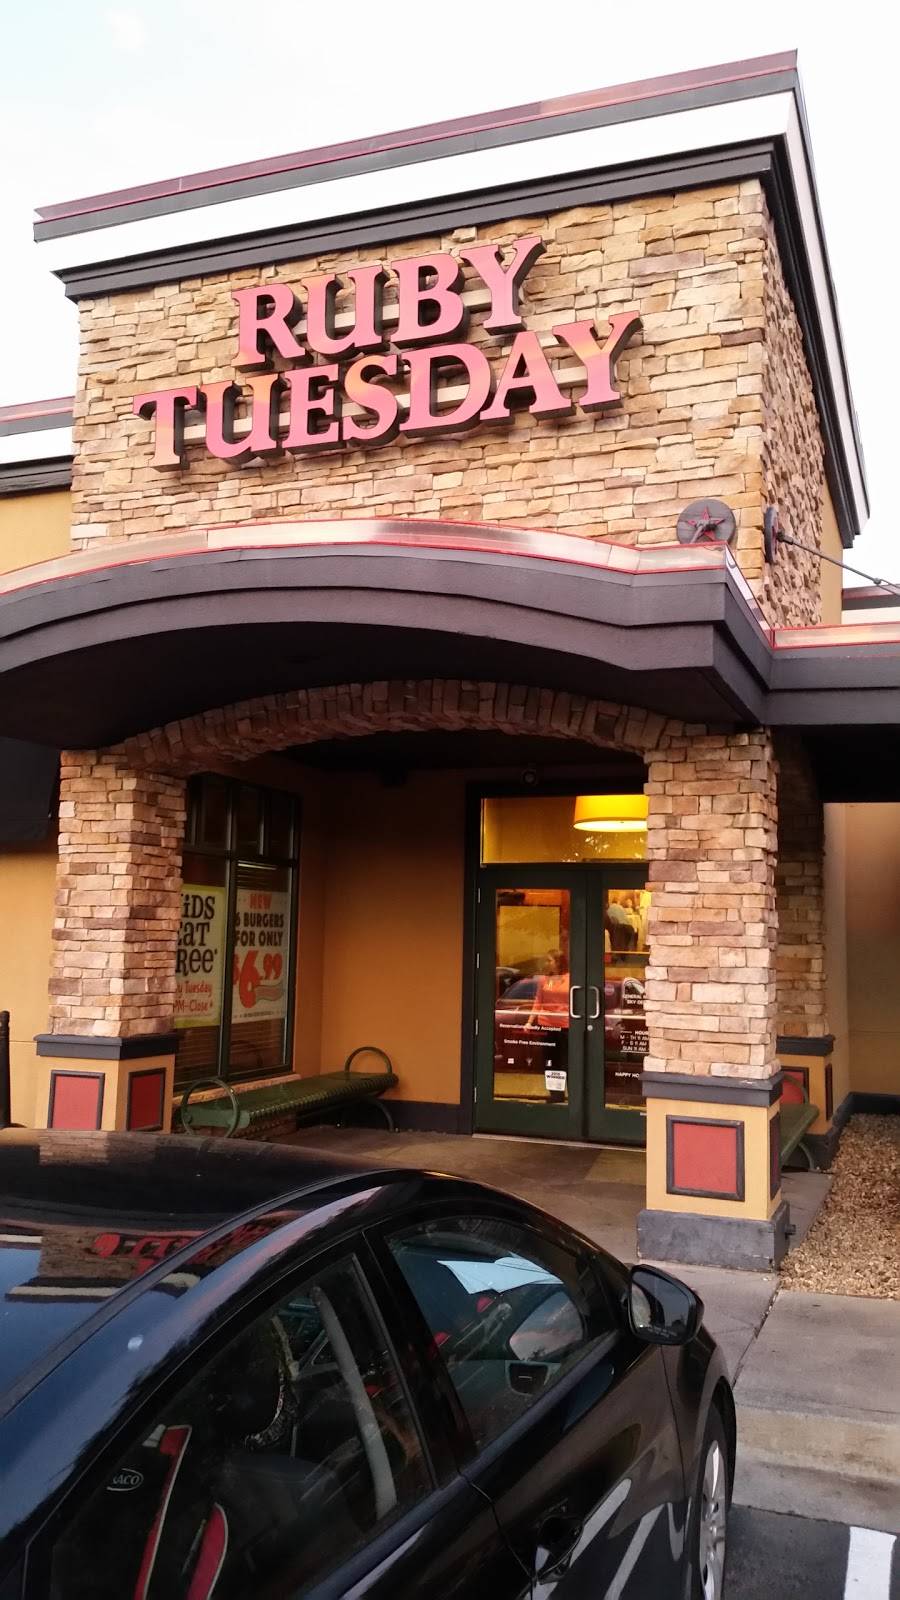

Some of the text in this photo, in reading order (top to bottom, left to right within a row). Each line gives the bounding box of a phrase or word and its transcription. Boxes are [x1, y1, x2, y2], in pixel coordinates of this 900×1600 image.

[231, 236, 547, 372] RUBY
[133, 311, 643, 472] TUESDAY
[243, 912, 284, 928] BURGERS
[258, 931, 283, 946] ONLY
